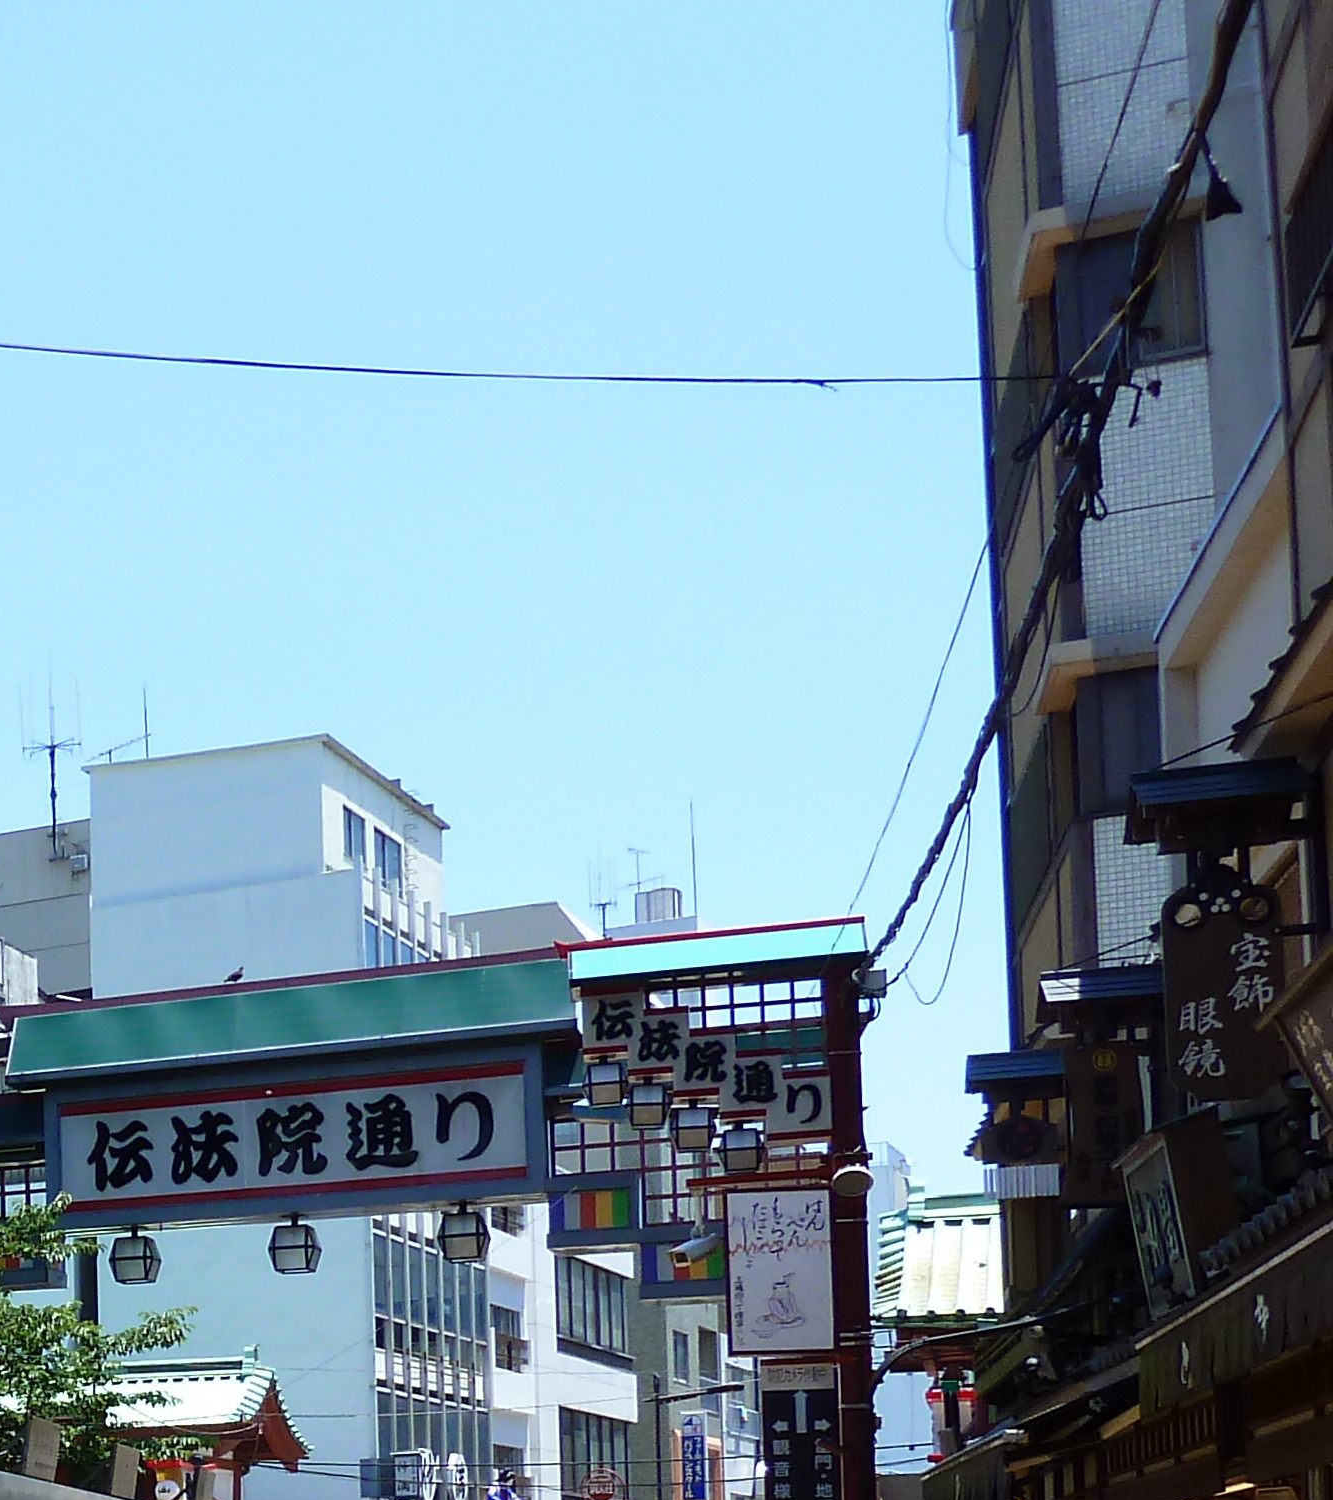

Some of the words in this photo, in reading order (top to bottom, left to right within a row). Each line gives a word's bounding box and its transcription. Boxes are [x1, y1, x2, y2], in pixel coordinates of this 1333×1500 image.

[1226, 932, 1276, 1011] 宝飾
[591, 998, 824, 1124] 伝法院通り
[1177, 997, 1226, 1078] 眼鏡
[86, 1090, 495, 1194] 伝法院通り
